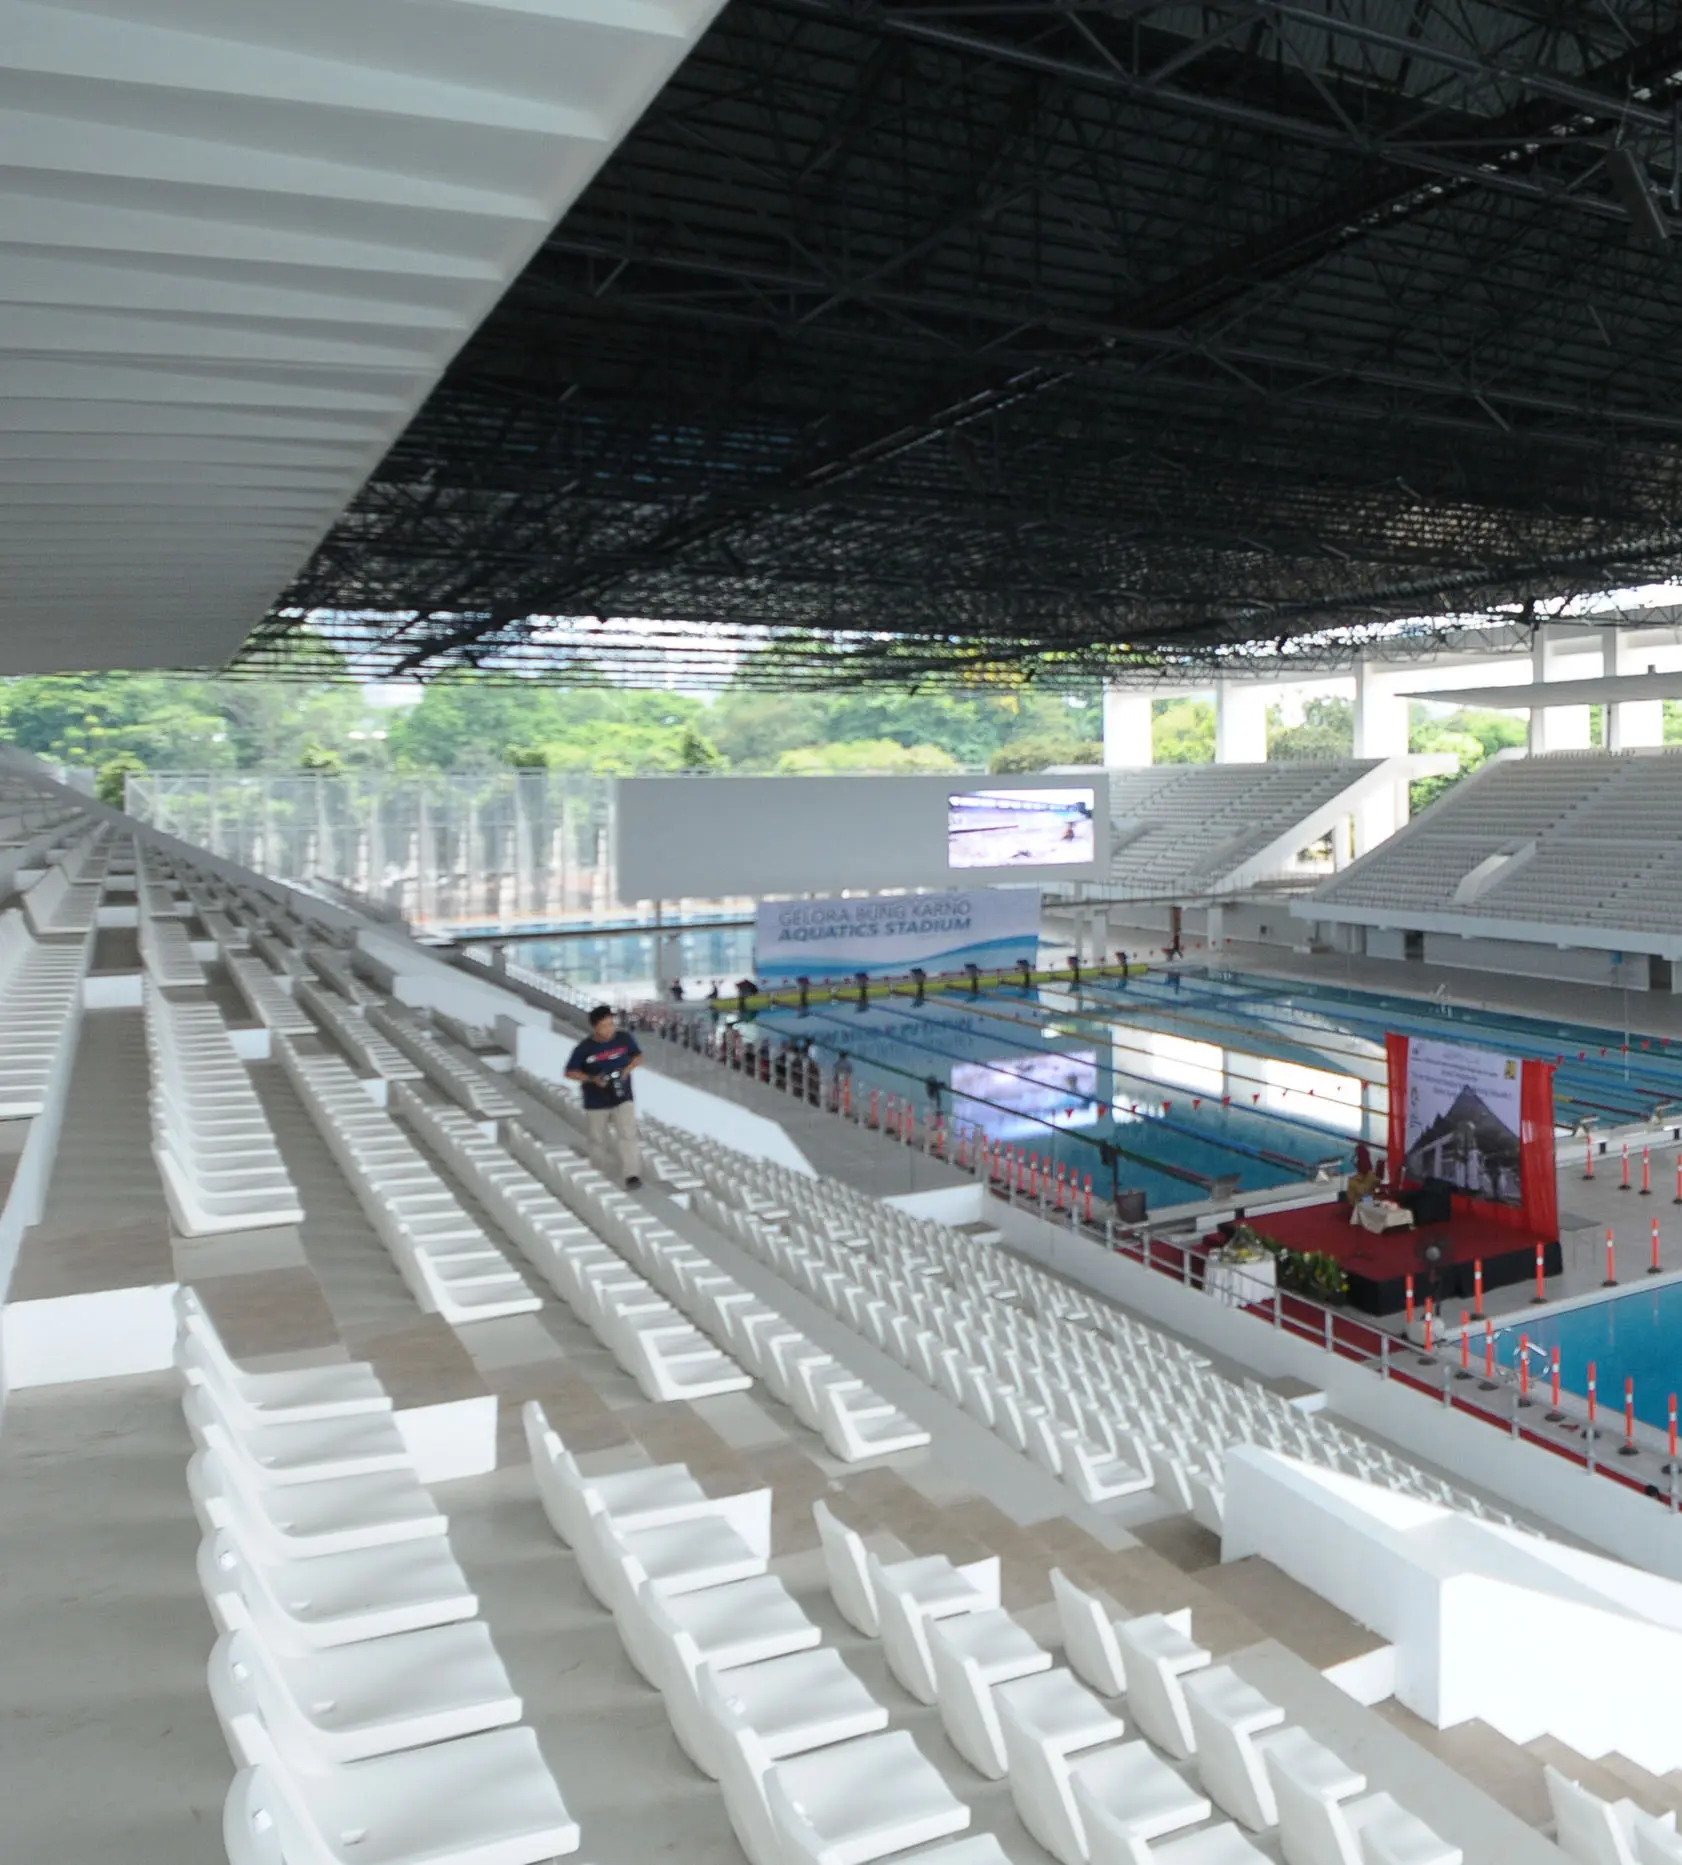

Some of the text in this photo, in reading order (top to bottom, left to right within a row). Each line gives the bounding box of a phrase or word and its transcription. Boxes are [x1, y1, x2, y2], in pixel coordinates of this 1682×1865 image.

[779, 900, 971, 926] GELORA BUNG KARNO
[778, 917, 971, 942] AQUATICS STADIUM
